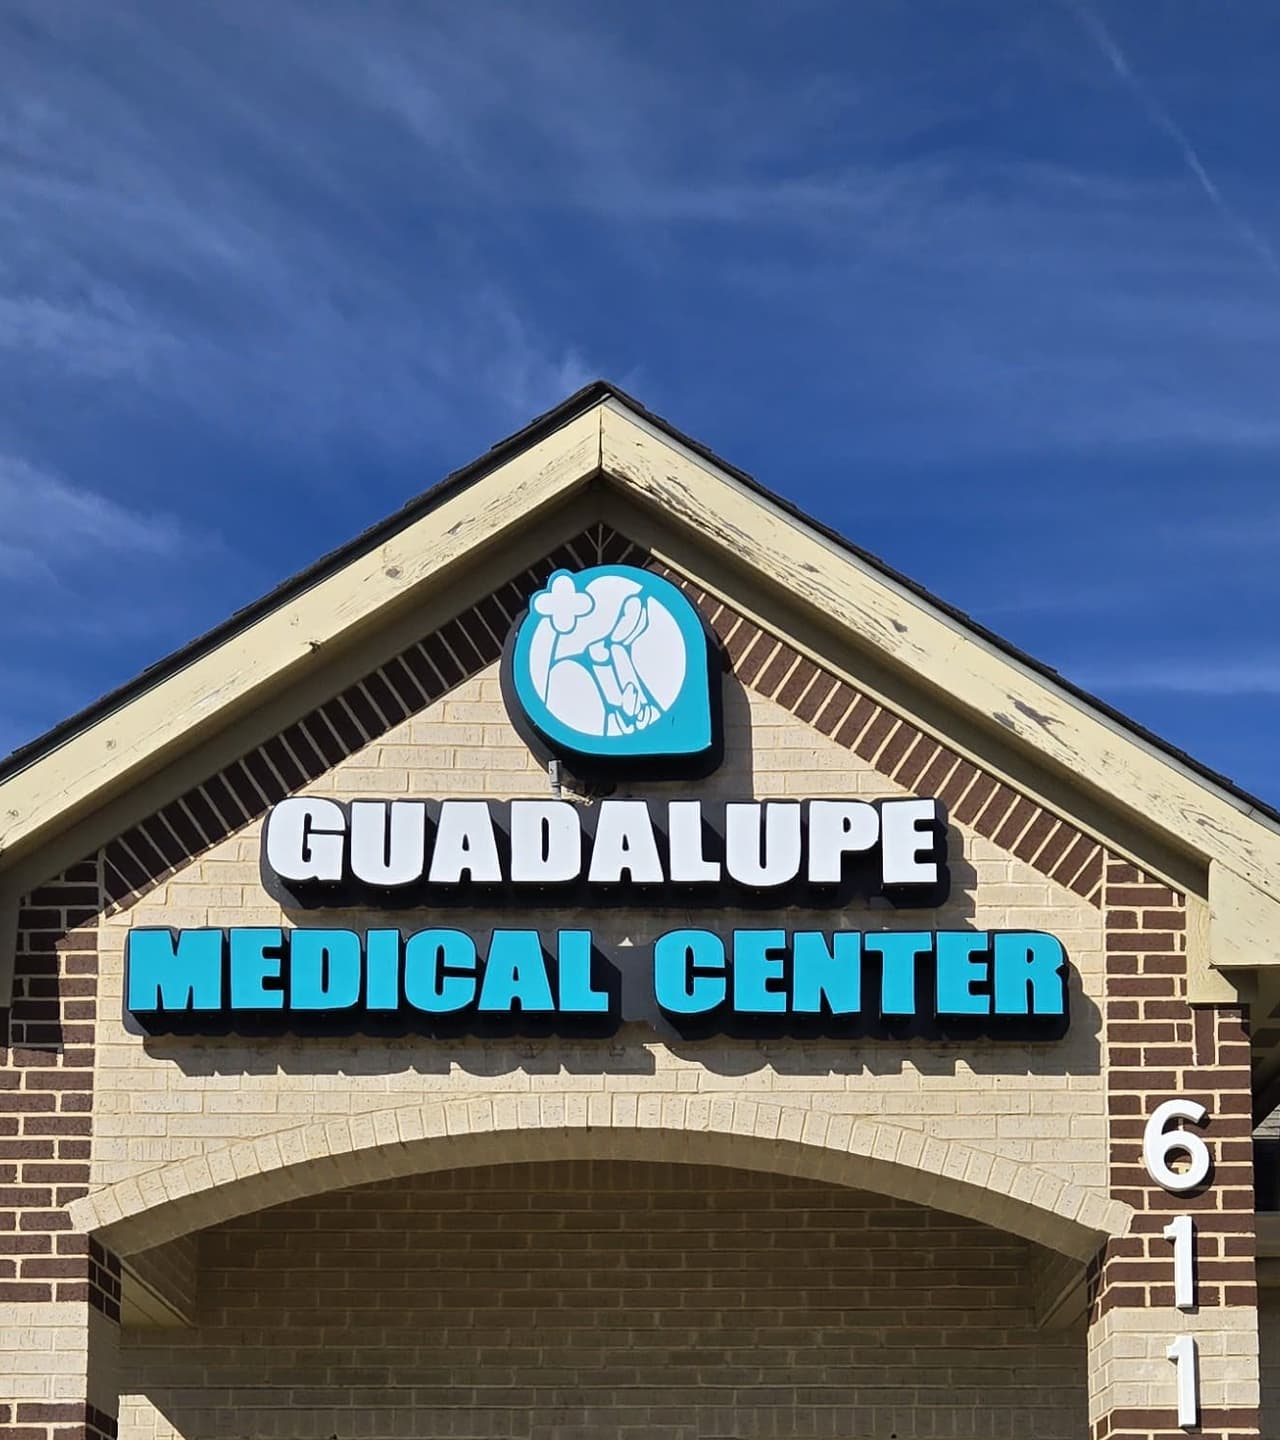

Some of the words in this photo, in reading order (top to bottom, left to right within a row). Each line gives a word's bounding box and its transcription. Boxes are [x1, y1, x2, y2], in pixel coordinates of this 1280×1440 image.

[267, 799, 938, 887] GUADALUPE
[130, 928, 609, 1014] MEDICAL
[655, 929, 1066, 1017] CENTER
[1143, 1099, 1210, 1427] 611
